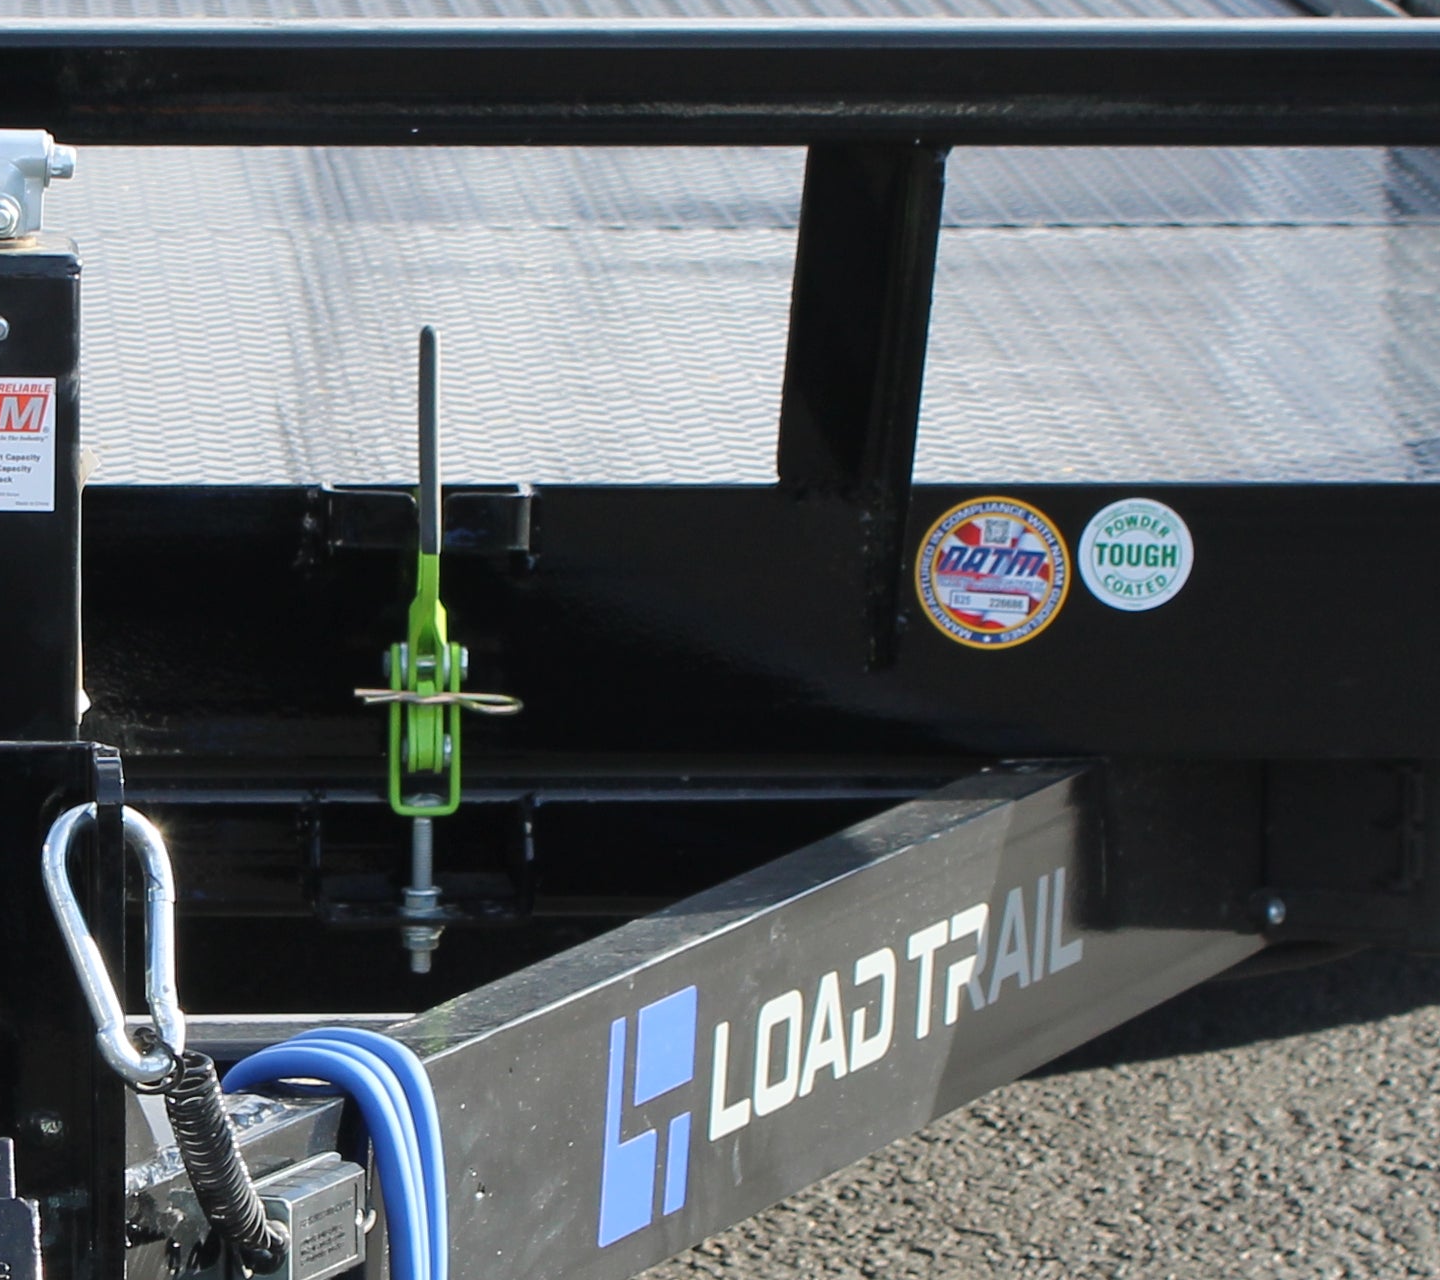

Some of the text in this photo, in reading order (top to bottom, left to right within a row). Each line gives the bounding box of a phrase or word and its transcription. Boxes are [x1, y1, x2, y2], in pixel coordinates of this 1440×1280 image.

[5, 453, 41, 462] Capacity
[942, 502, 1025, 530] COMPLIANCE
[1027, 513, 1054, 543] WITH
[1104, 515, 1170, 538] POWDER
[931, 529, 943, 546] IN
[938, 545, 1048, 577] NATM
[1051, 542, 1065, 588] NATM
[1095, 543, 1177, 567] TOUGH
[920, 548, 972, 640] MANUFACTURED
[1104, 574, 1167, 596] COATED
[1000, 588, 1061, 642] GUIDELINES
[709, 867, 1083, 1142] LOAD TRAIL
